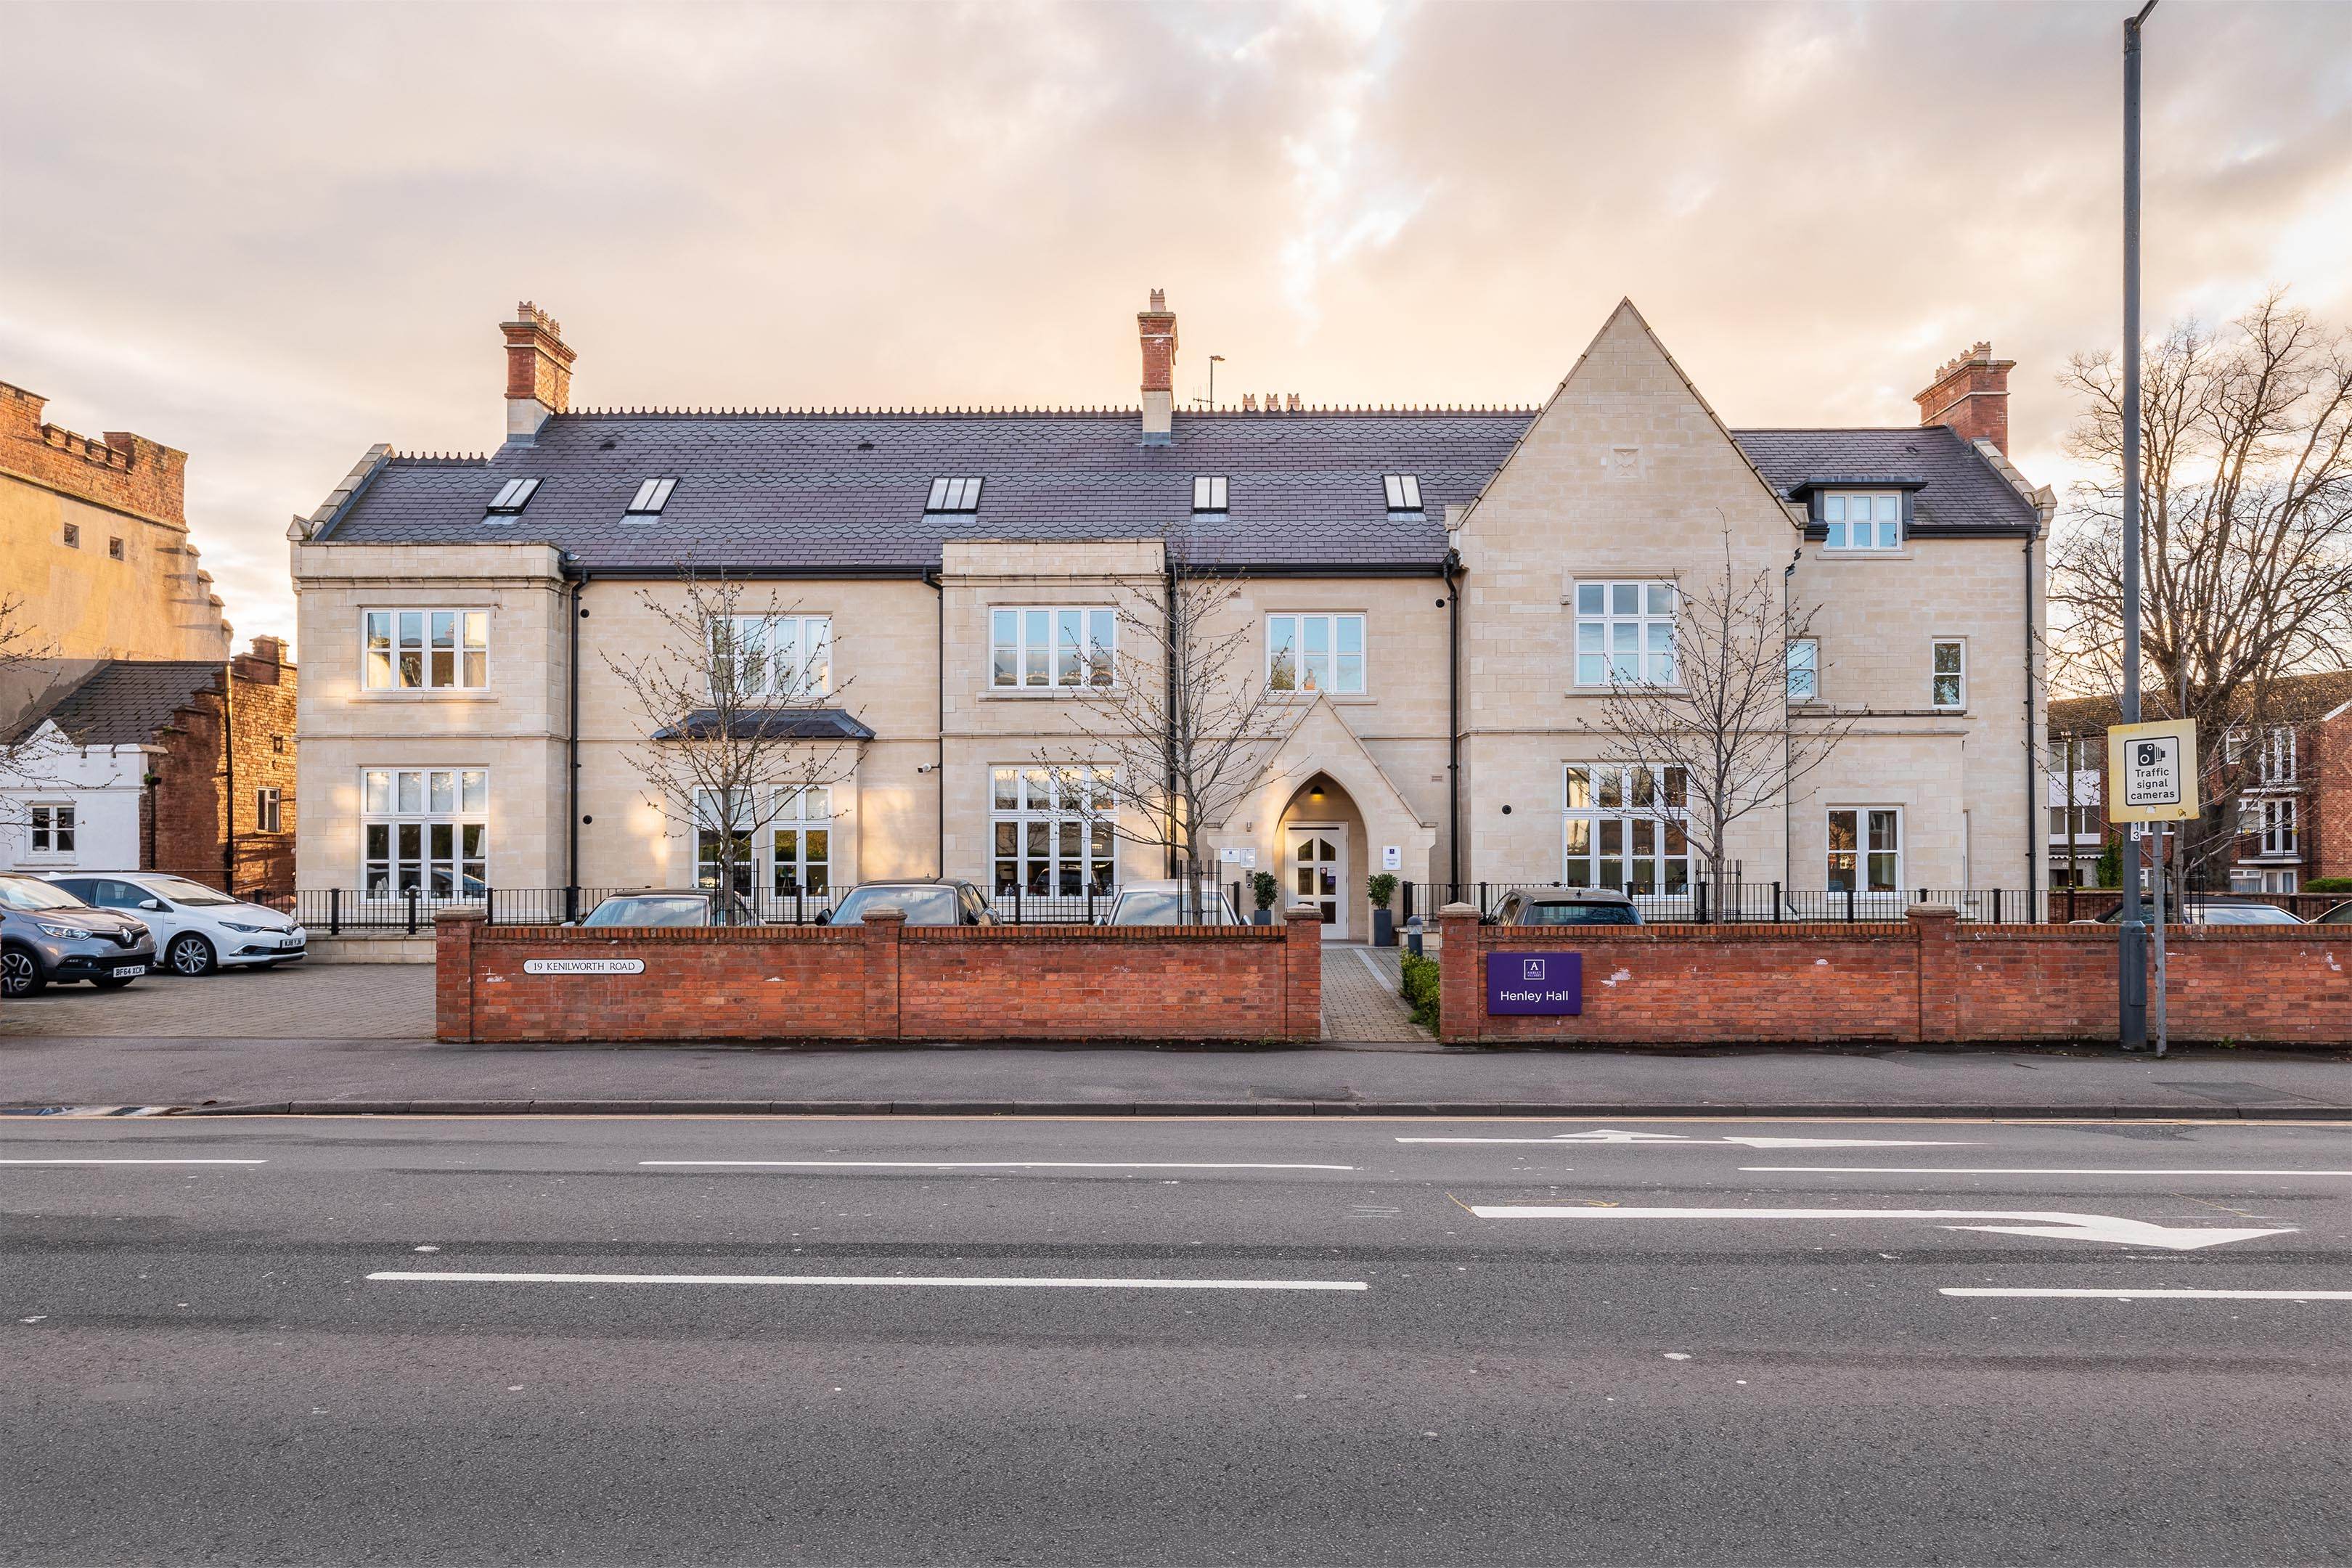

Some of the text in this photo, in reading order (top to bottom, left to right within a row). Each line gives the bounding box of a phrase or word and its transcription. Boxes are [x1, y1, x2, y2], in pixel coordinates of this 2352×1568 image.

[2135, 768, 2169, 777] Traffic
[2137, 778, 2168, 789] signal
[2131, 791, 2175, 800] cameras
[1500, 990, 1568, 1003] Henley Hall
